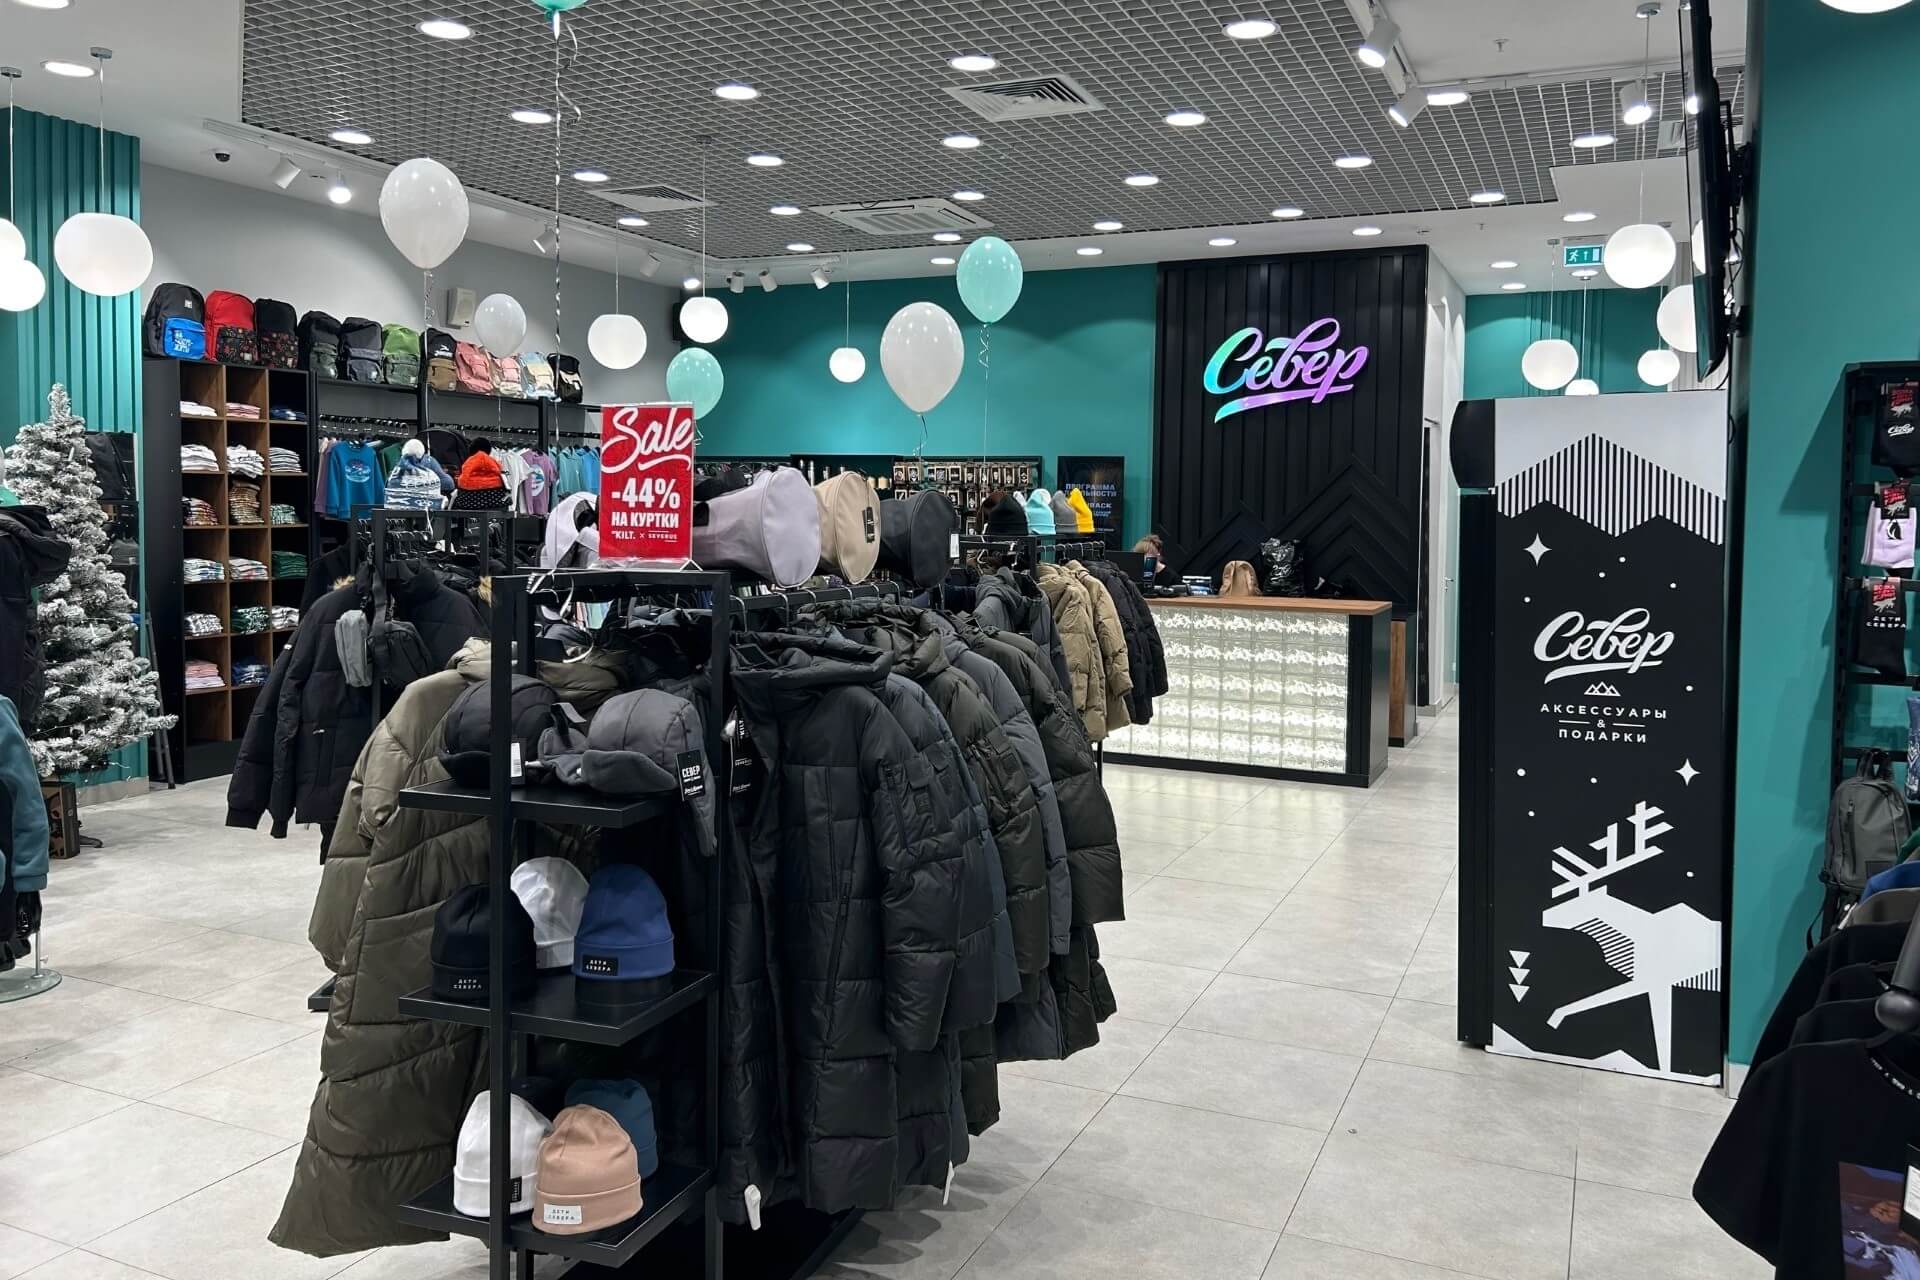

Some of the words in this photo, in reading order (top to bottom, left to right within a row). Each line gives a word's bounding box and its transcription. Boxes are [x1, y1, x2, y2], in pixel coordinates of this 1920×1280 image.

[1203, 318, 1369, 423] Север
[601, 407, 694, 473] Sale
[611, 478, 680, 509] -44%
[611, 511, 628, 527] НА
[630, 513, 679, 529] КУРТКИ
[1533, 608, 1675, 684] Север
[1540, 703, 1667, 719] АКСЕССУАРЫ
[1558, 728, 1647, 743] ПОДАРКИ
[1597, 719, 1606, 728] &
